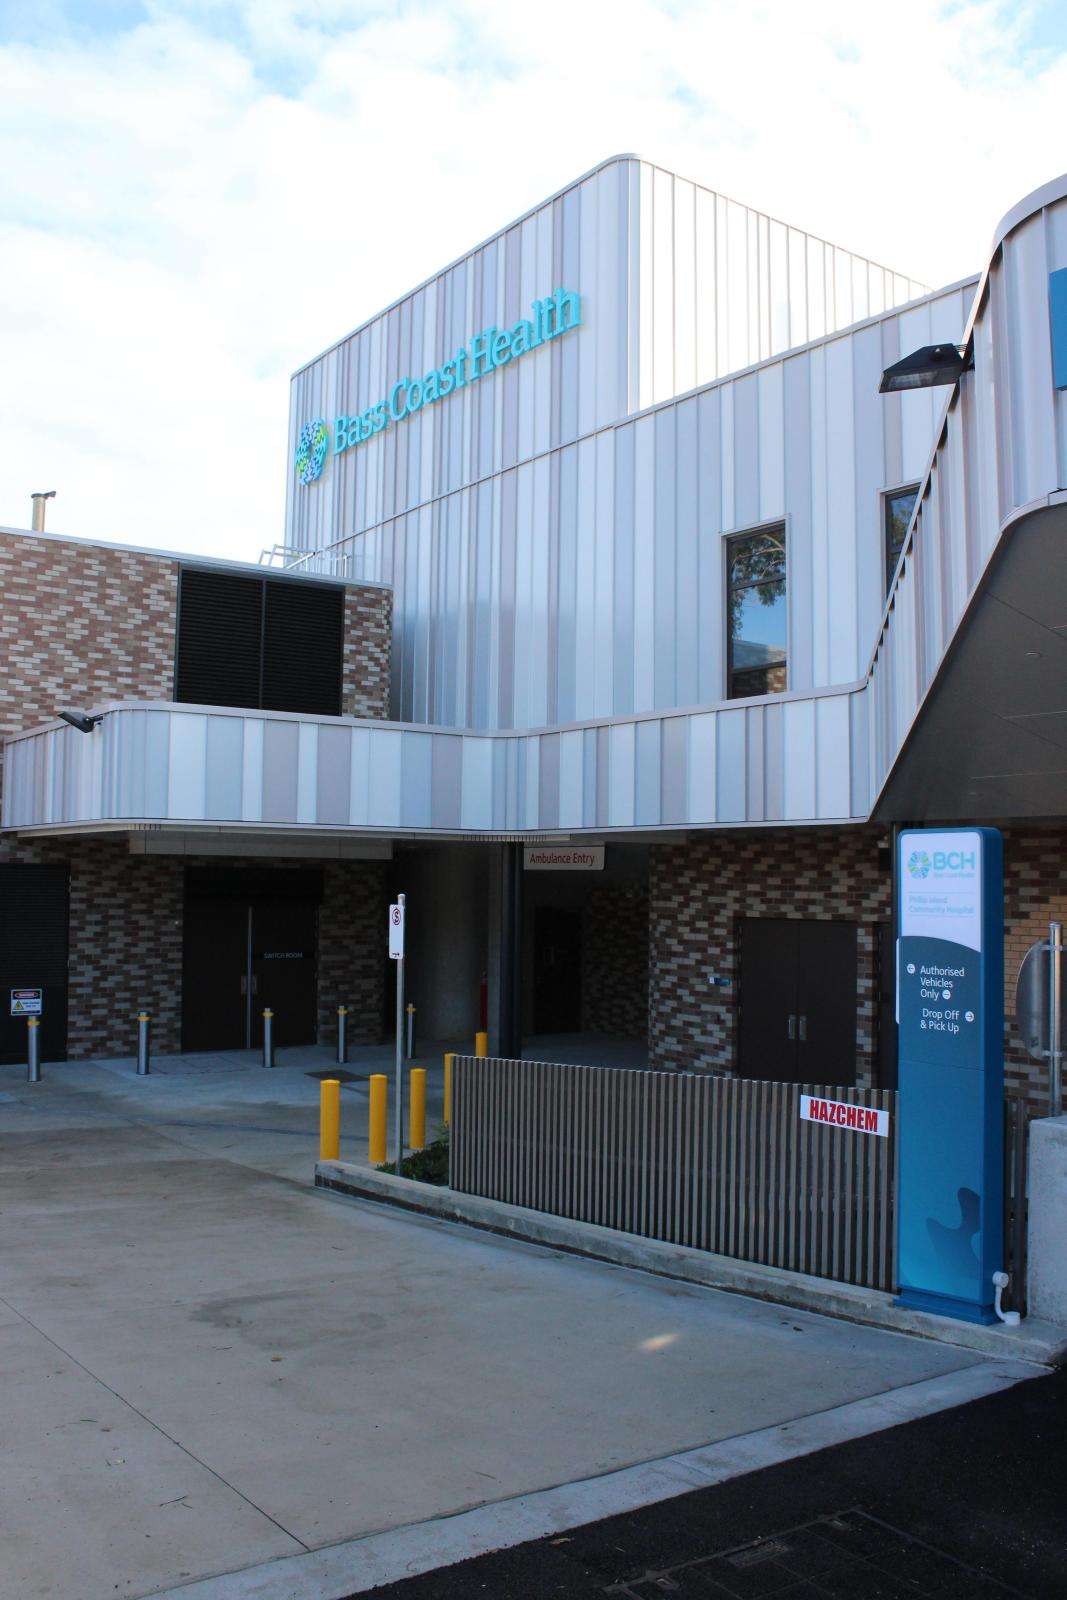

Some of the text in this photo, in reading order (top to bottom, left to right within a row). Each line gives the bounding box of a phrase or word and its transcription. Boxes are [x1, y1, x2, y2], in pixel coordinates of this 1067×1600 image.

[333, 287, 583, 456] Bass Coast Health
[530, 853, 595, 867] Ambulance Entry
[933, 852, 975, 870] BCH
[920, 965, 964, 977] Authorised
[920, 977, 953, 988] Vehicles
[920, 989, 939, 1001] Only
[922, 1008, 960, 1021] Drop Off
[920, 1021, 959, 1035] & Pick Up
[809, 1099, 878, 1133] HAZCHEM
